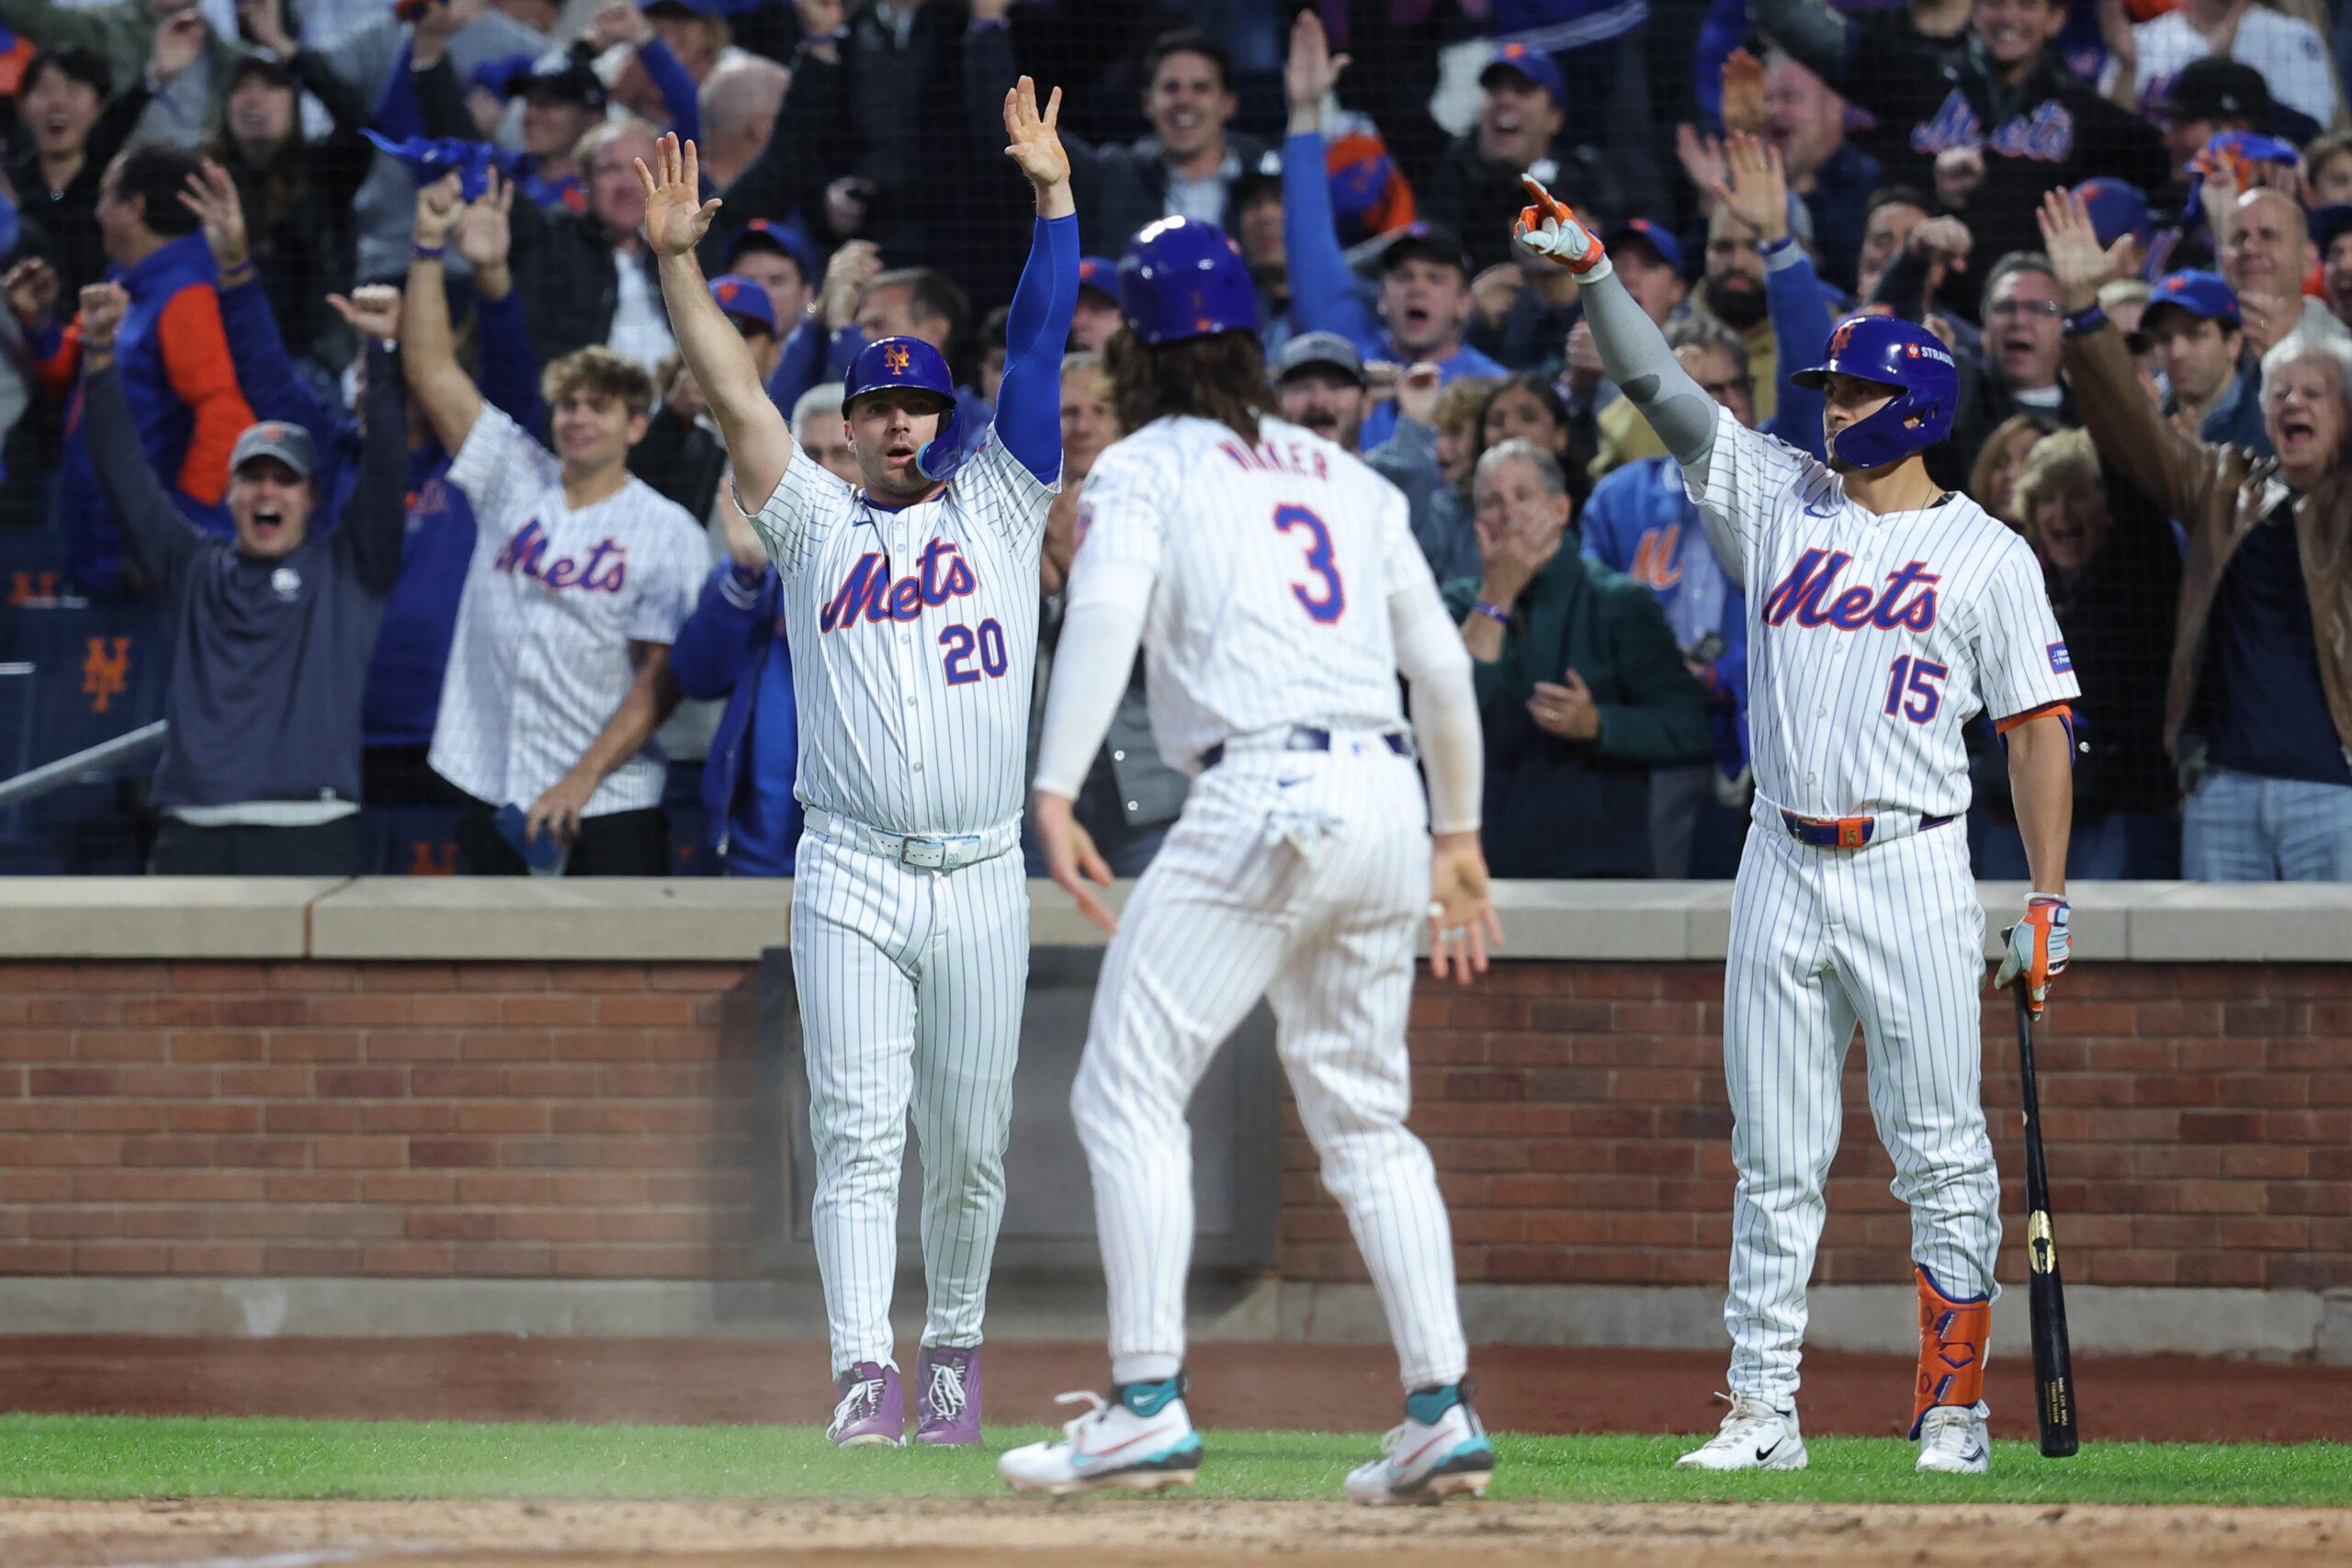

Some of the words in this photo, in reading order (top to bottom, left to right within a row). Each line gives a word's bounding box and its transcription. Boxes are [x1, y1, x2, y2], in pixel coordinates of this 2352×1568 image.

[494, 516, 628, 595] Mets
[820, 536, 977, 634] Mets
[1273, 502, 1346, 626] 3
[1762, 547, 1942, 633] Mets
[938, 616, 1009, 687] 20
[1884, 653, 1949, 726] 15
[947, 852, 960, 866] 20
[1843, 829, 1858, 845] 15
